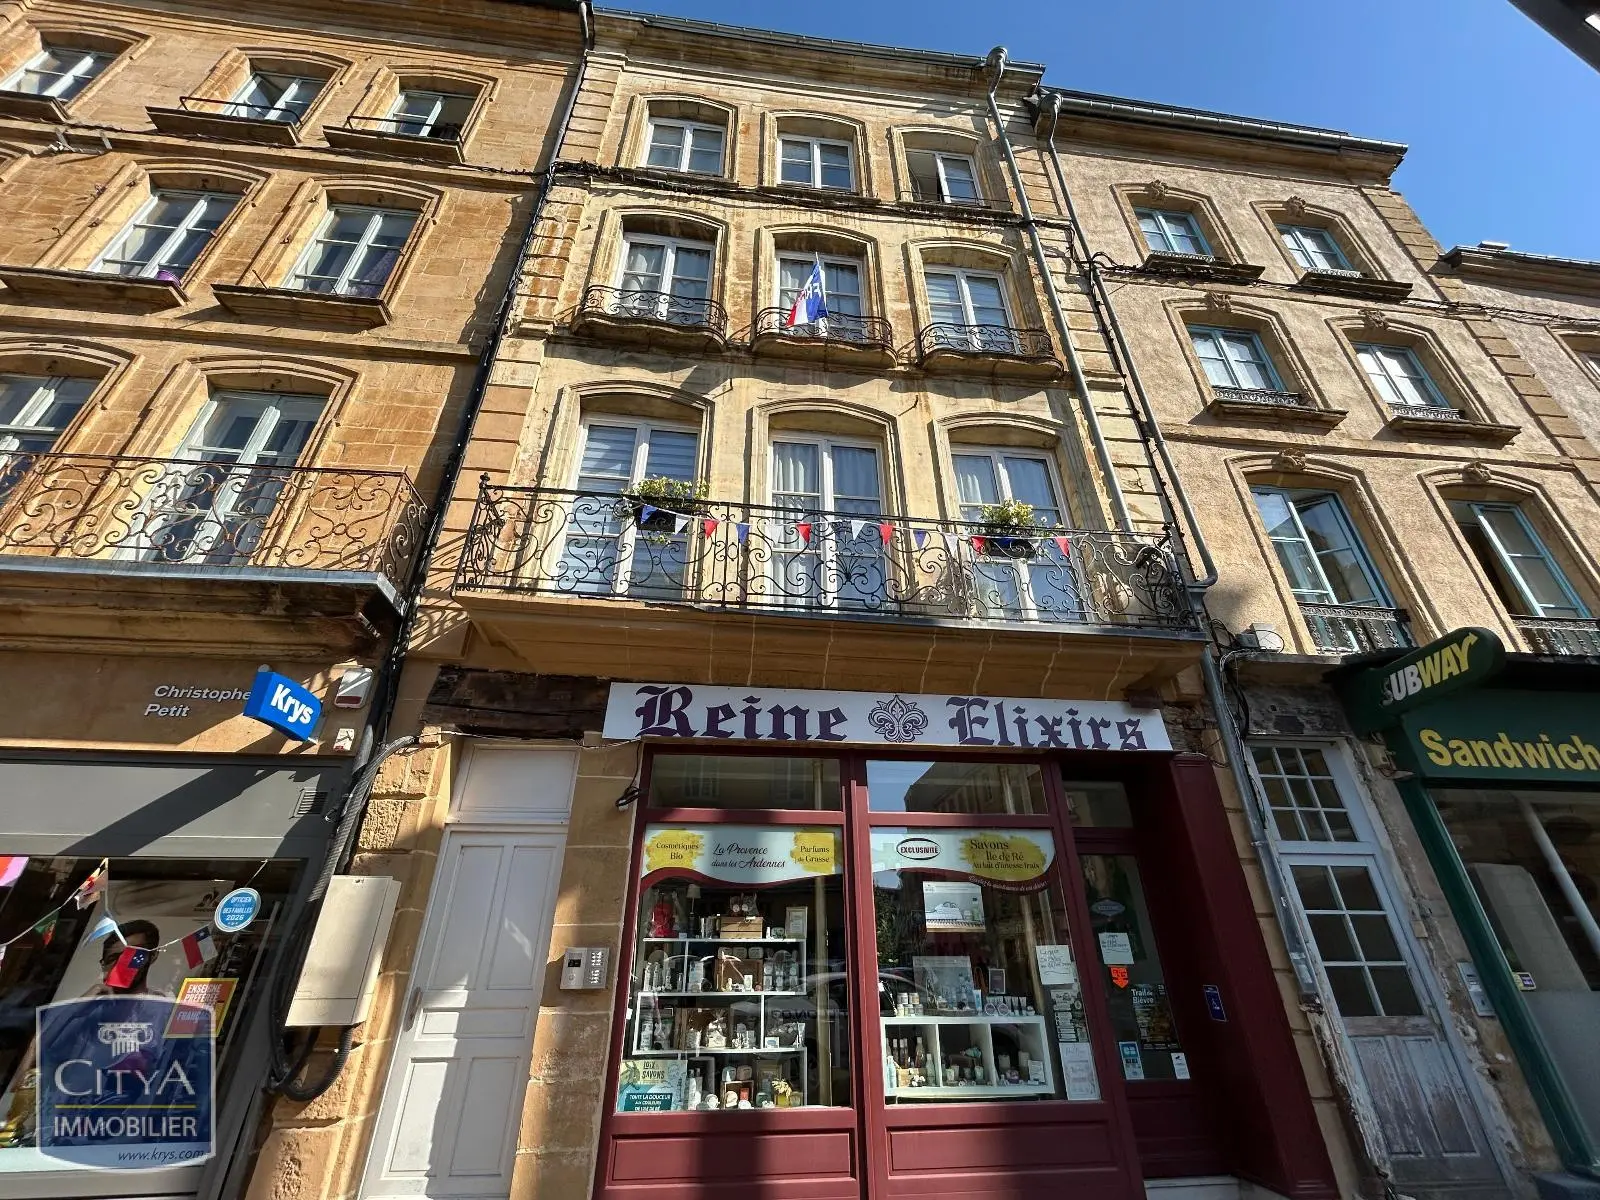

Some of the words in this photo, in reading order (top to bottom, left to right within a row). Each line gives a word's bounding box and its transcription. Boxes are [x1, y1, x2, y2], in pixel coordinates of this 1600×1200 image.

[1380, 632, 1480, 706] SUBWAY
[154, 685, 251, 702] Christophe
[144, 703, 191, 717] Petit
[270, 683, 314, 725] Krys
[635, 685, 848, 741] Reine
[946, 696, 1148, 750] Elixirs
[1419, 728, 1600, 771] Sandwich
[713, 843, 726, 856] La
[725, 842, 769, 855] Provence
[800, 844, 830, 853] Parfums
[970, 839, 1009, 850] Savons
[670, 851, 683, 860] Bio
[805, 855, 830, 863] Grasse
[1012, 851, 1024, 861] Ré
[711, 859, 727, 868] dans
[738, 857, 786, 869] Ardennes
[187, 983, 222, 994] ENSEIGNE
[118, 1147, 204, 1163] www.krys.com
